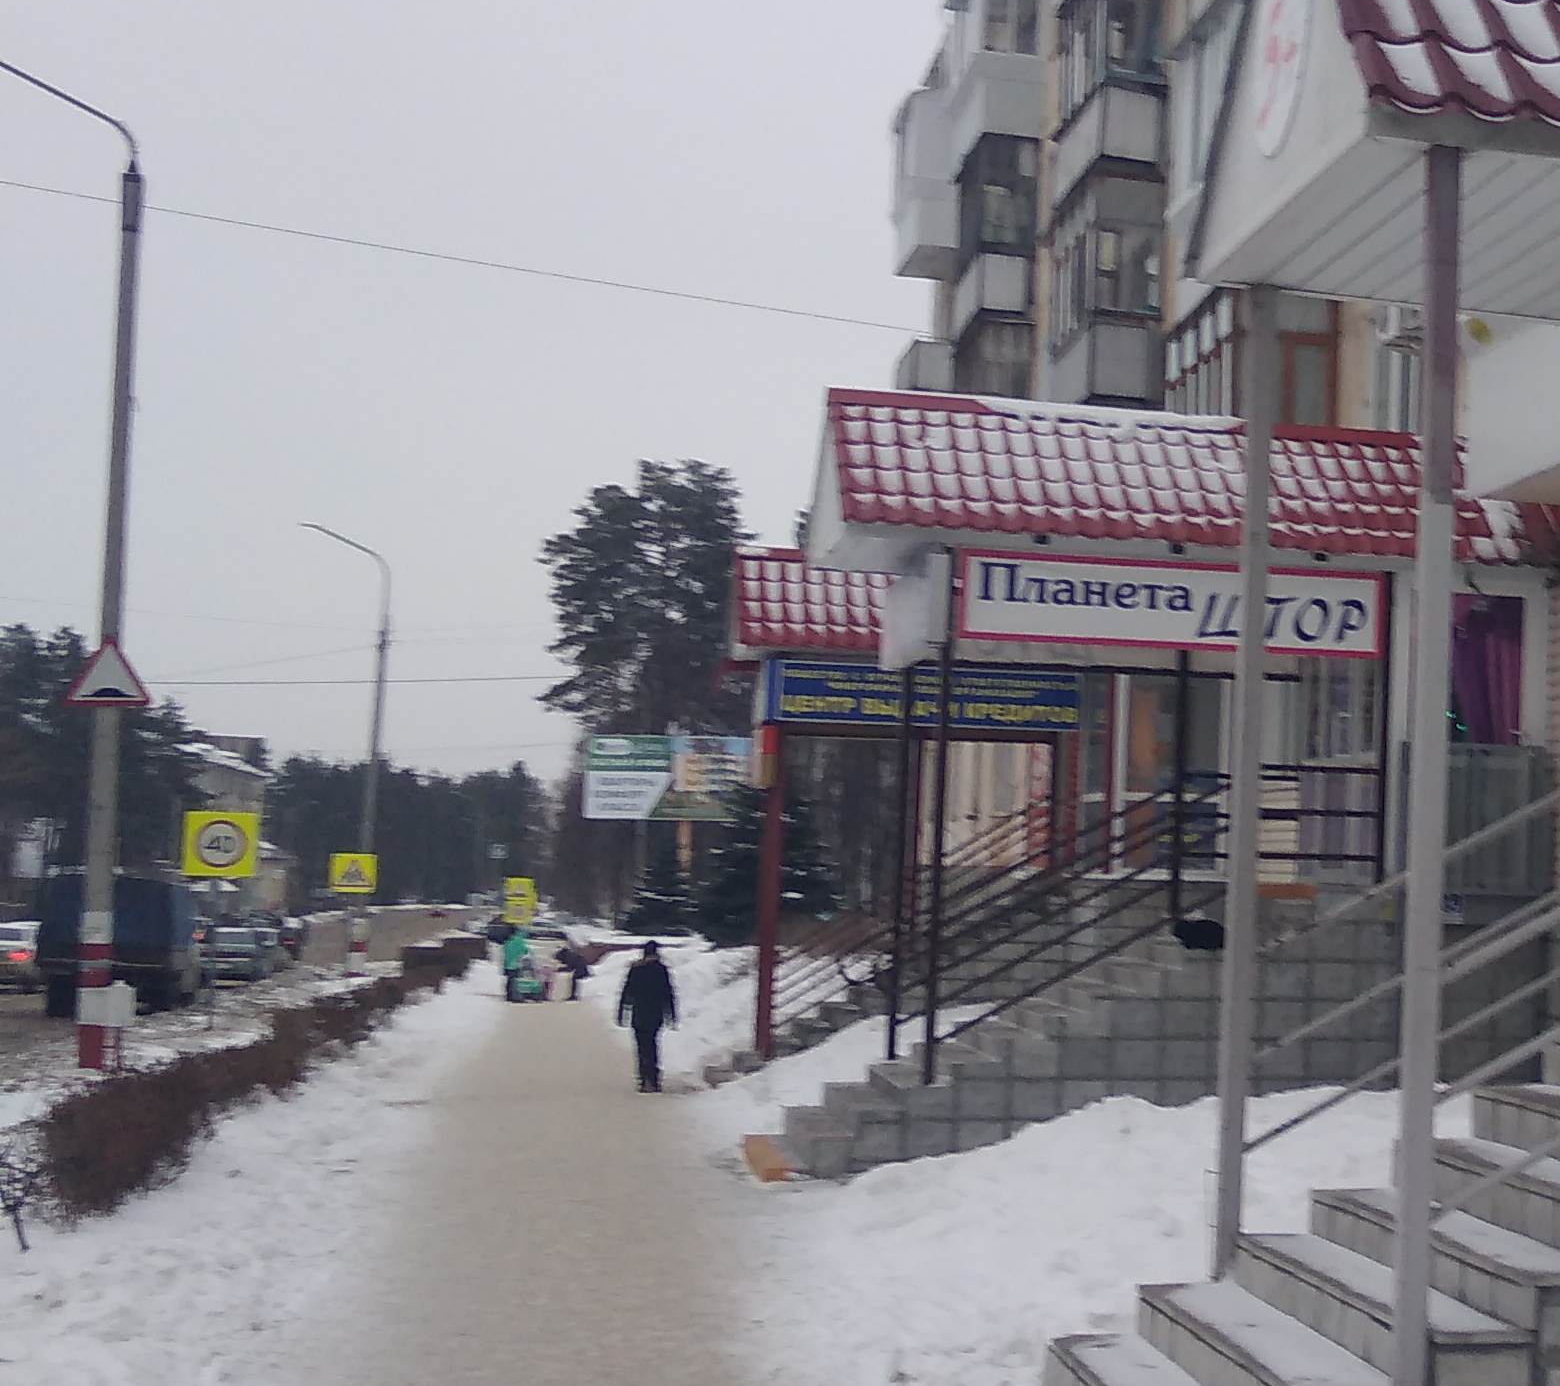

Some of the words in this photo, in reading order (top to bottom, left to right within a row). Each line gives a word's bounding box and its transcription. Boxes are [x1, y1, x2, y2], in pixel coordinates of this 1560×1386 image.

[977, 561, 1195, 612] Планета
[1195, 592, 1369, 644] ШТОР
[203, 835, 236, 854] 40
